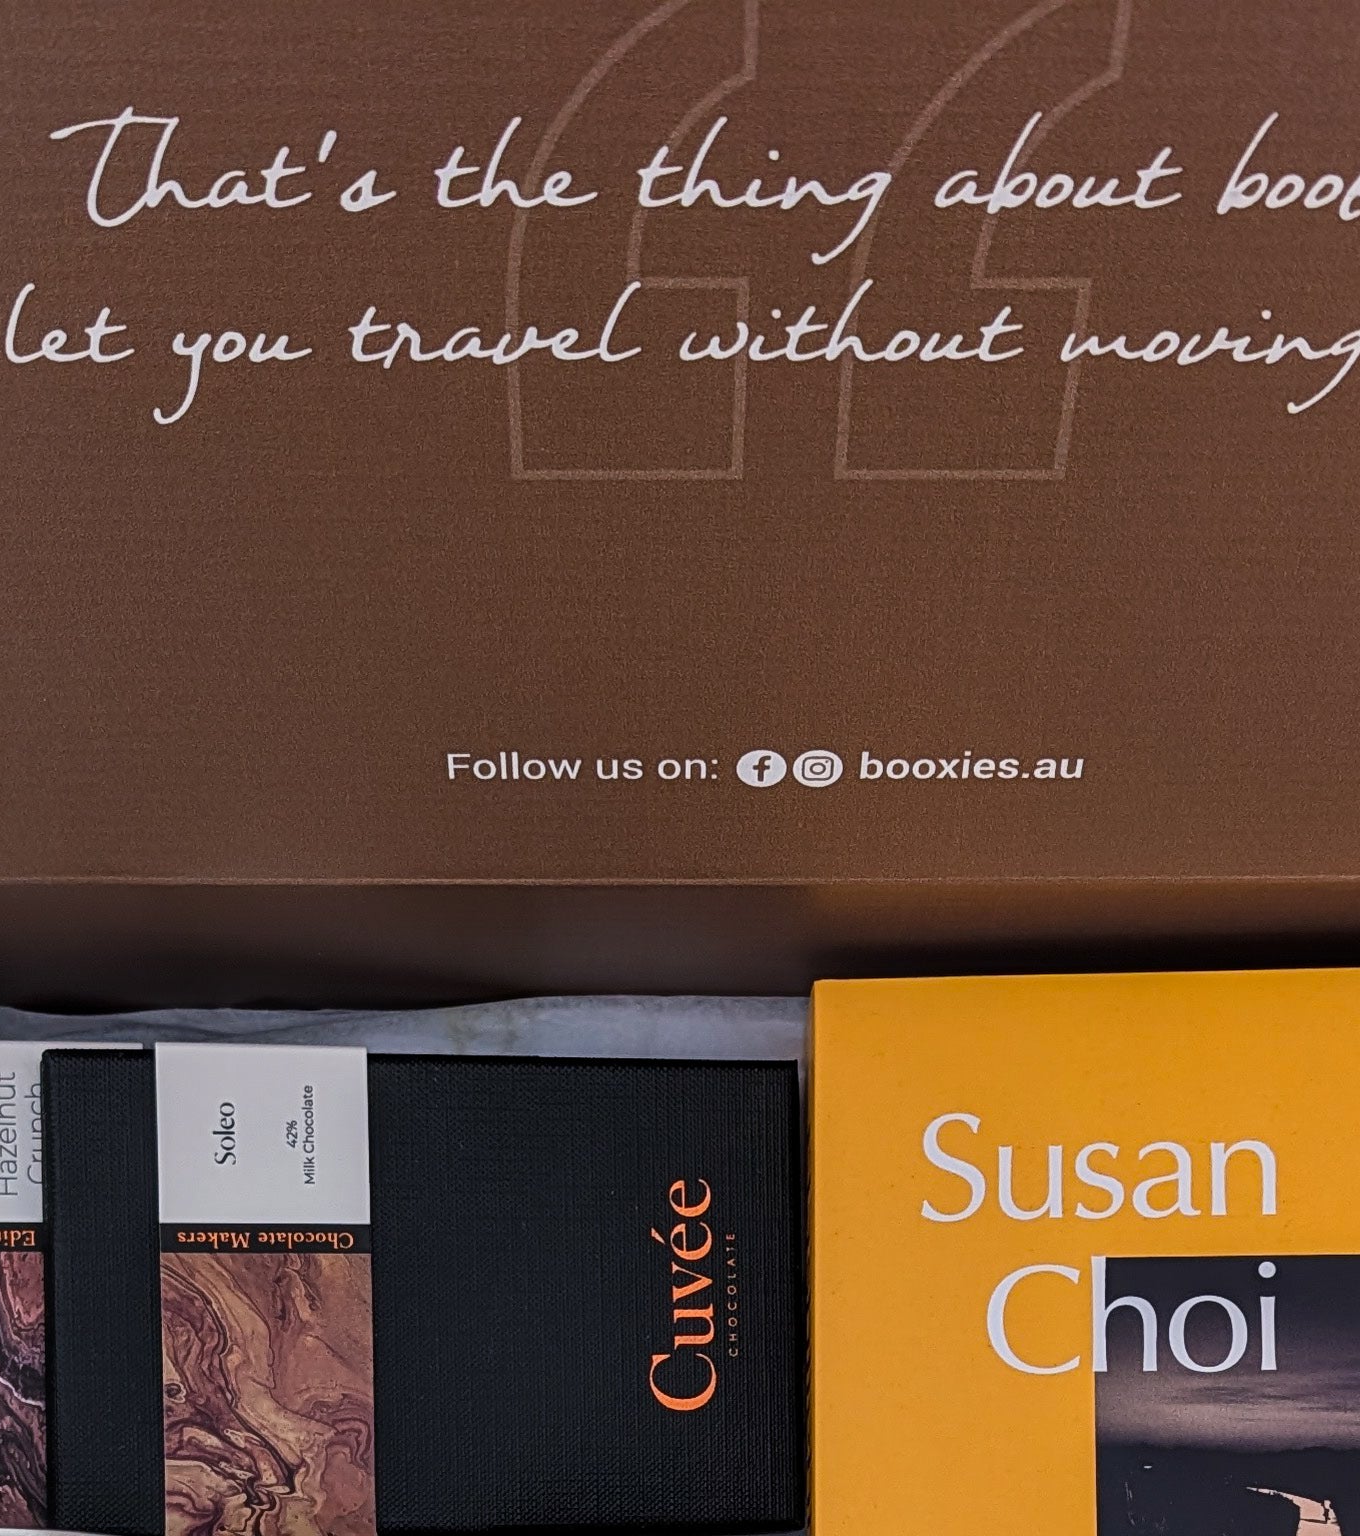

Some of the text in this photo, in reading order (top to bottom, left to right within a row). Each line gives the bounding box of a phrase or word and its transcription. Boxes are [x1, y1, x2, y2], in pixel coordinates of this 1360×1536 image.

[50, 107, 396, 227] That's
[436, 117, 597, 208] the
[638, 117, 892, 264] thing
[934, 113, 1181, 214] about
[6, 283, 135, 363] let
[153, 331, 312, 425] you
[349, 281, 641, 369] travel
[679, 279, 1023, 363] without
[446, 751, 1084, 780] Follow us on: booxies.au
[213, 1102, 236, 1165] Soleo
[286, 1120, 297, 1148] 42%
[301, 1085, 315, 1185] Milk Chocolate
[920, 1112, 1278, 1223] Susan
[178, 1232, 354, 1249] Chocolate Makers
[649, 1178, 717, 1411] Cuvée
[726, 1232, 738, 1357] CHOCOLATE
[987, 1255, 1278, 1376] Choi
